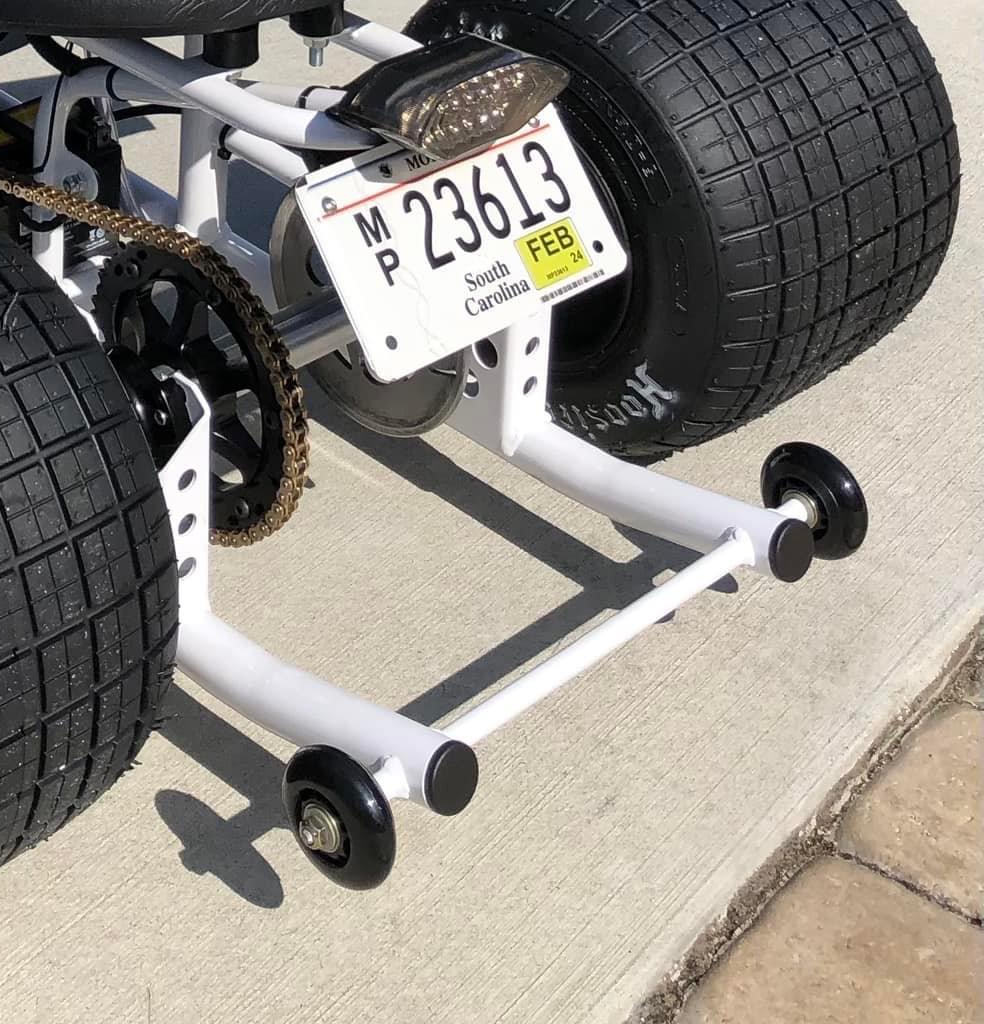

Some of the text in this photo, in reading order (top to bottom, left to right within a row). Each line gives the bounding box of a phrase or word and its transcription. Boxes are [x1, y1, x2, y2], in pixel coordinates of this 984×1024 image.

[402, 141, 572, 270] 23613
[526, 225, 575, 263] FEB
[569, 249, 584, 264] 24
[464, 260, 511, 293] South
[464, 278, 532, 317] Carolina
